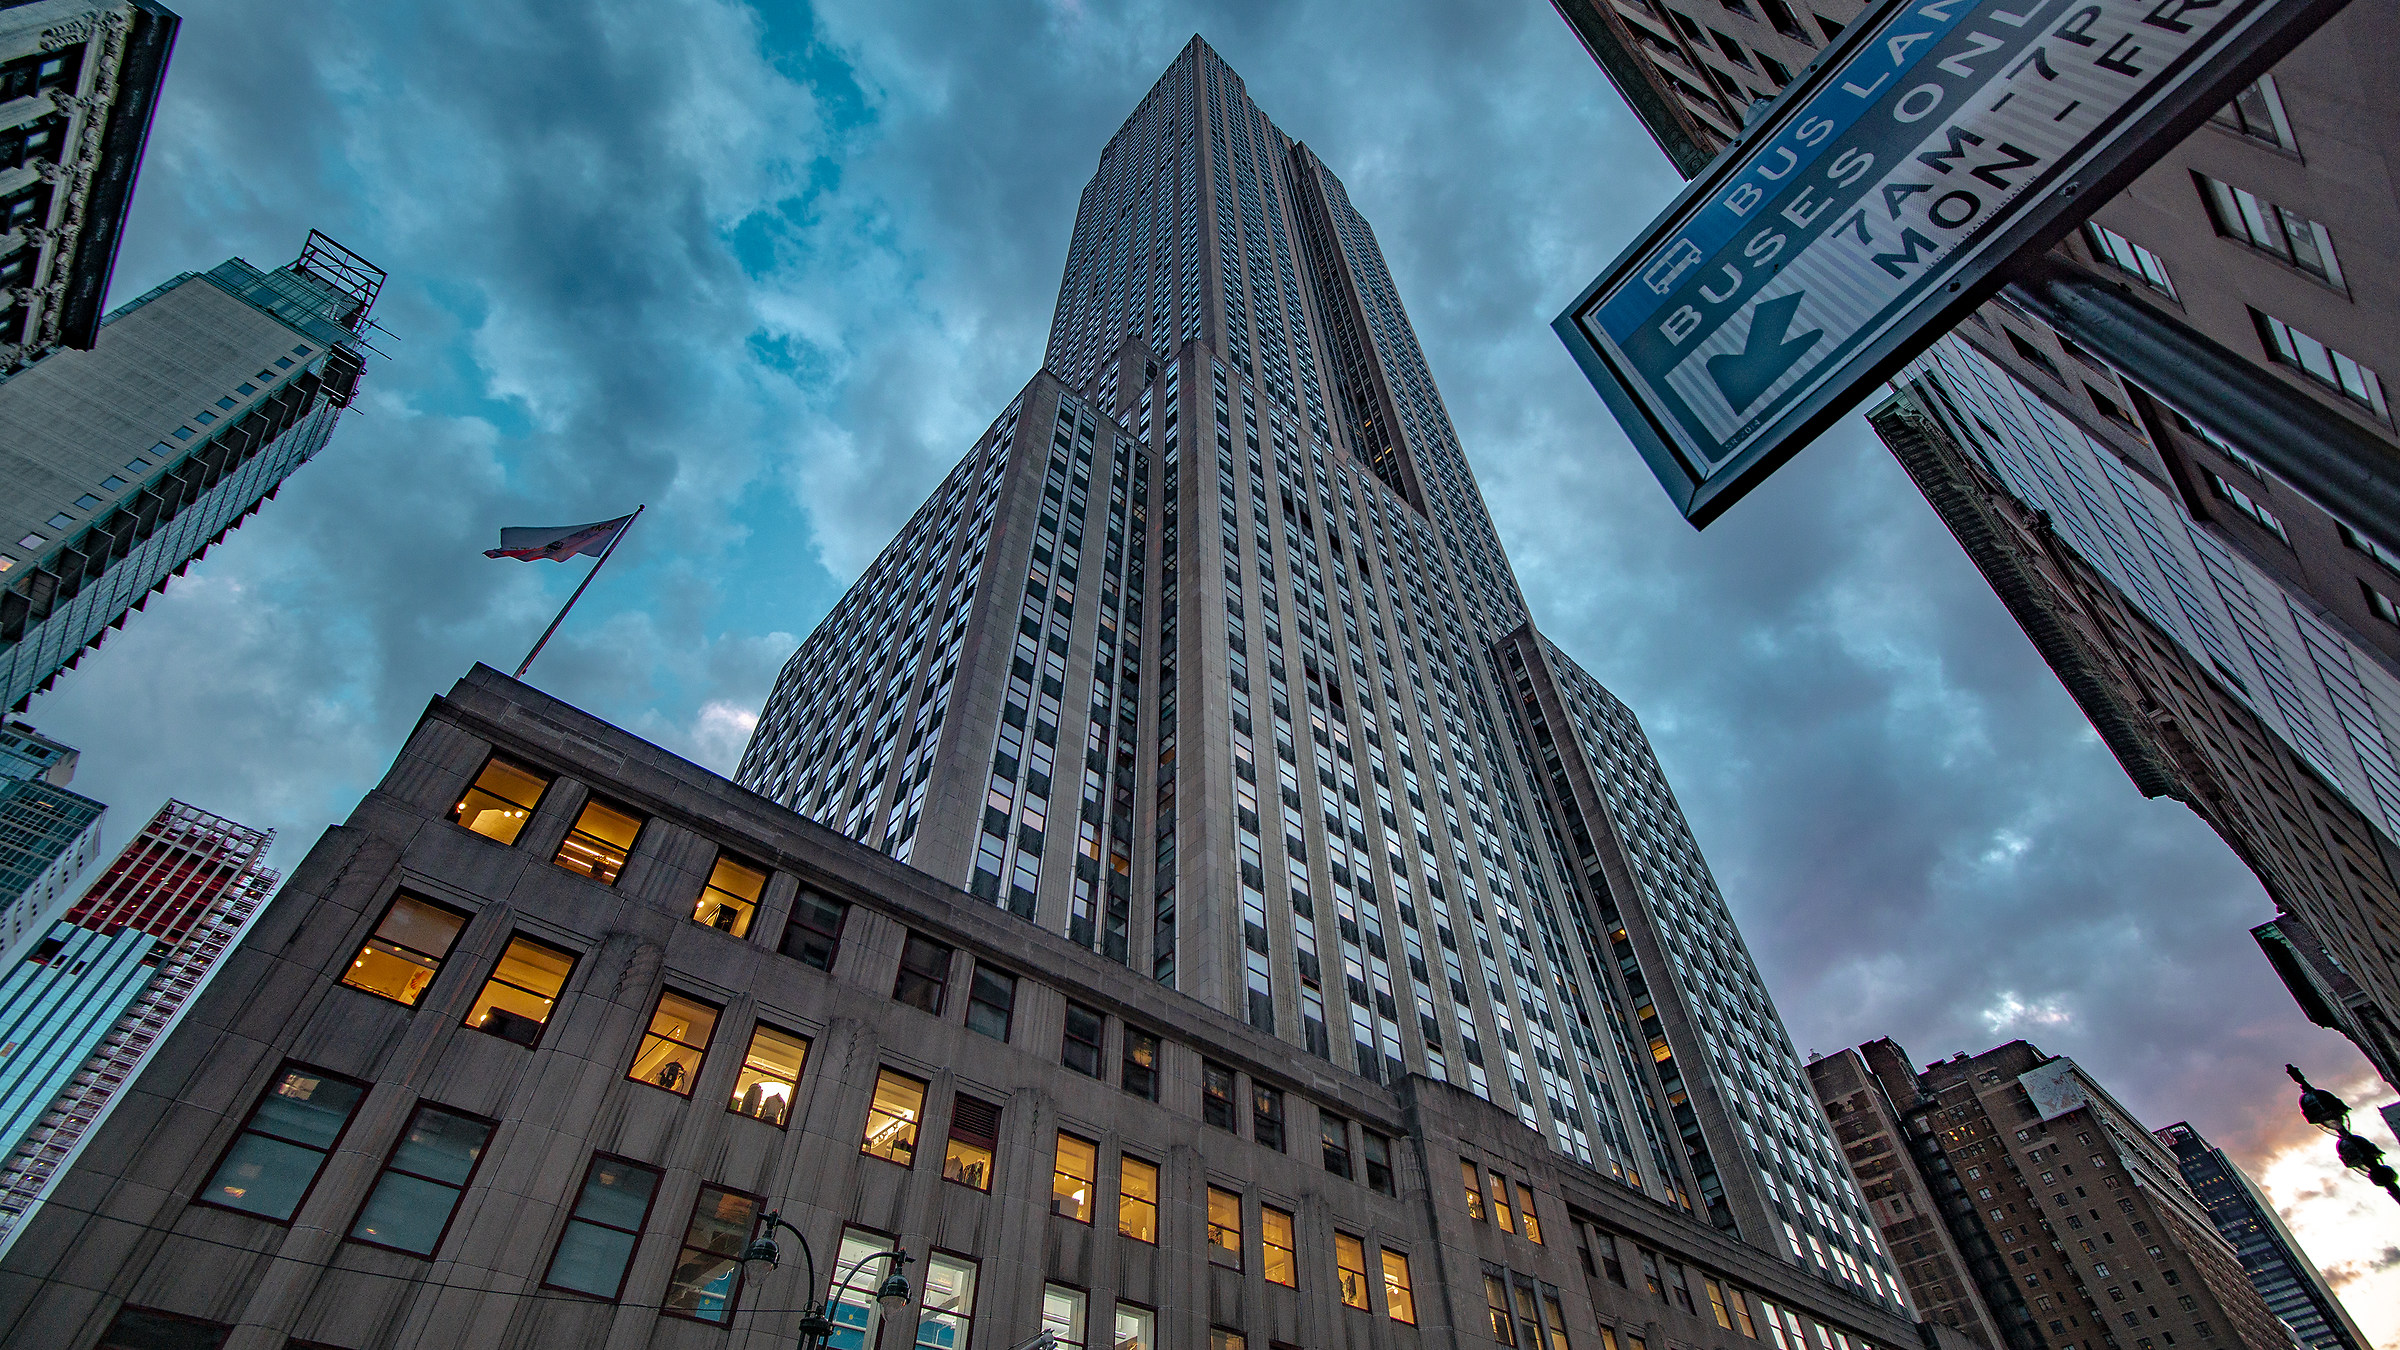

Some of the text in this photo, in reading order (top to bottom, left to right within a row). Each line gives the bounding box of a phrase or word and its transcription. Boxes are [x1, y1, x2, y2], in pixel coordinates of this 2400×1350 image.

[1658, 0, 2049, 347] BUSES ONL
[1723, 115, 1834, 217] BUS
[1831, 125, 1985, 246] 7AM
[2006, 0, 2140, 81] 7P
[1871, 142, 2040, 280] MON
[2093, 0, 2222, 78] FR
[1962, 175, 2037, 240] TRANSPORTATION
